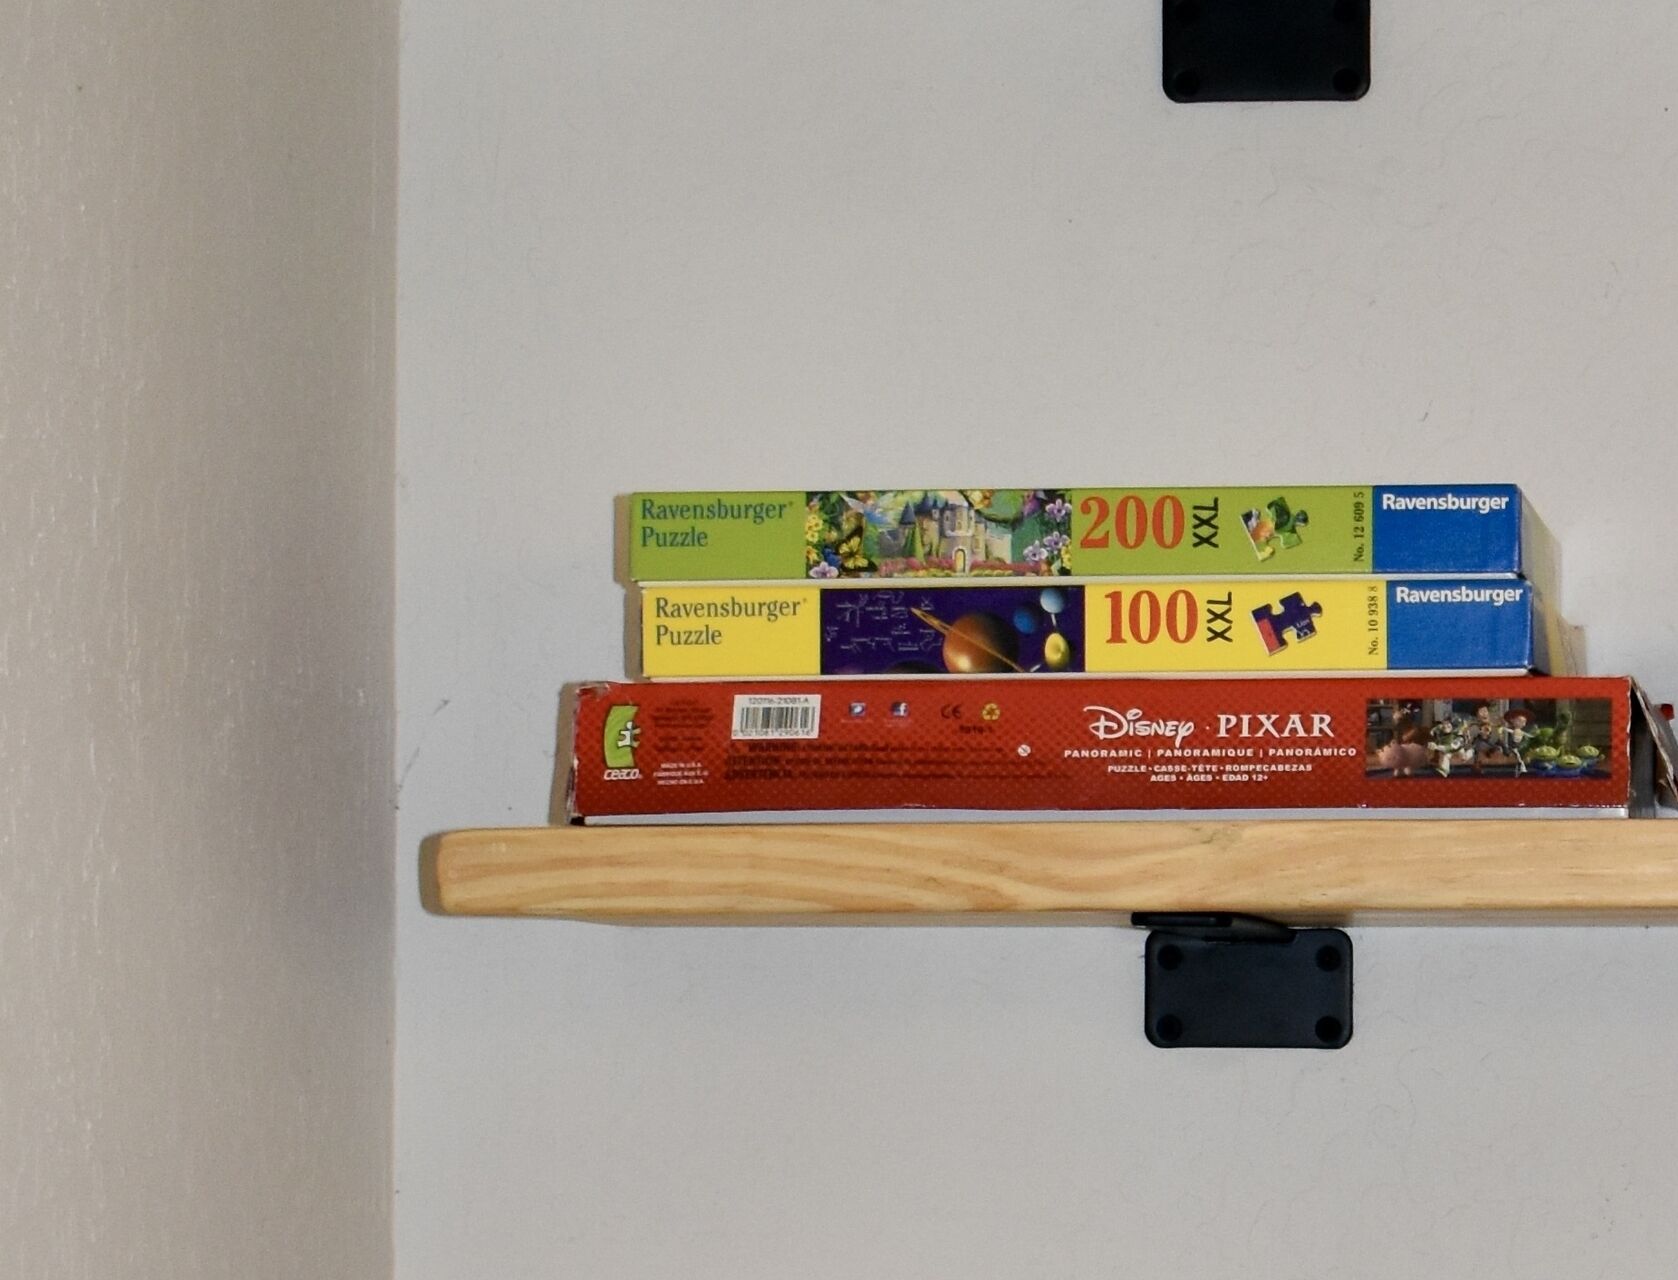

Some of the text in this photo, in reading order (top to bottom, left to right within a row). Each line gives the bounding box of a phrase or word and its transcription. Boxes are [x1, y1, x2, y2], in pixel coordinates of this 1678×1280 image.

[640, 498, 787, 524] Ravensburger
[1353, 502, 1365, 524] 609
[1382, 494, 1509, 512] Ravensburger
[1079, 495, 1185, 550] 200
[1192, 496, 1220, 549] XXL
[1353, 527, 1365, 539] 12
[641, 526, 708, 548] Puzzle
[1353, 544, 1365, 562] No.
[1396, 586, 1523, 606] Ravensburger
[656, 598, 800, 622] Ravensburger
[1104, 588, 1199, 645] 100
[1206, 592, 1233, 642] XXL
[1368, 585, 1380, 656] No. 10 938 8
[656, 625, 722, 646] Puzzle
[1216, 713, 1335, 738] PIXAR
[1064, 746, 1358, 759] PANORAMIC PANORAMIQUE PANORÁMICO
[1108, 763, 1314, 773] PUZZLE CASSE-TÊTE ROMPECABEZAS
[1150, 774, 1177, 782] AGES
[1222, 774, 1250, 782] EDAD
[1252, 774, 1269, 782] 12+
